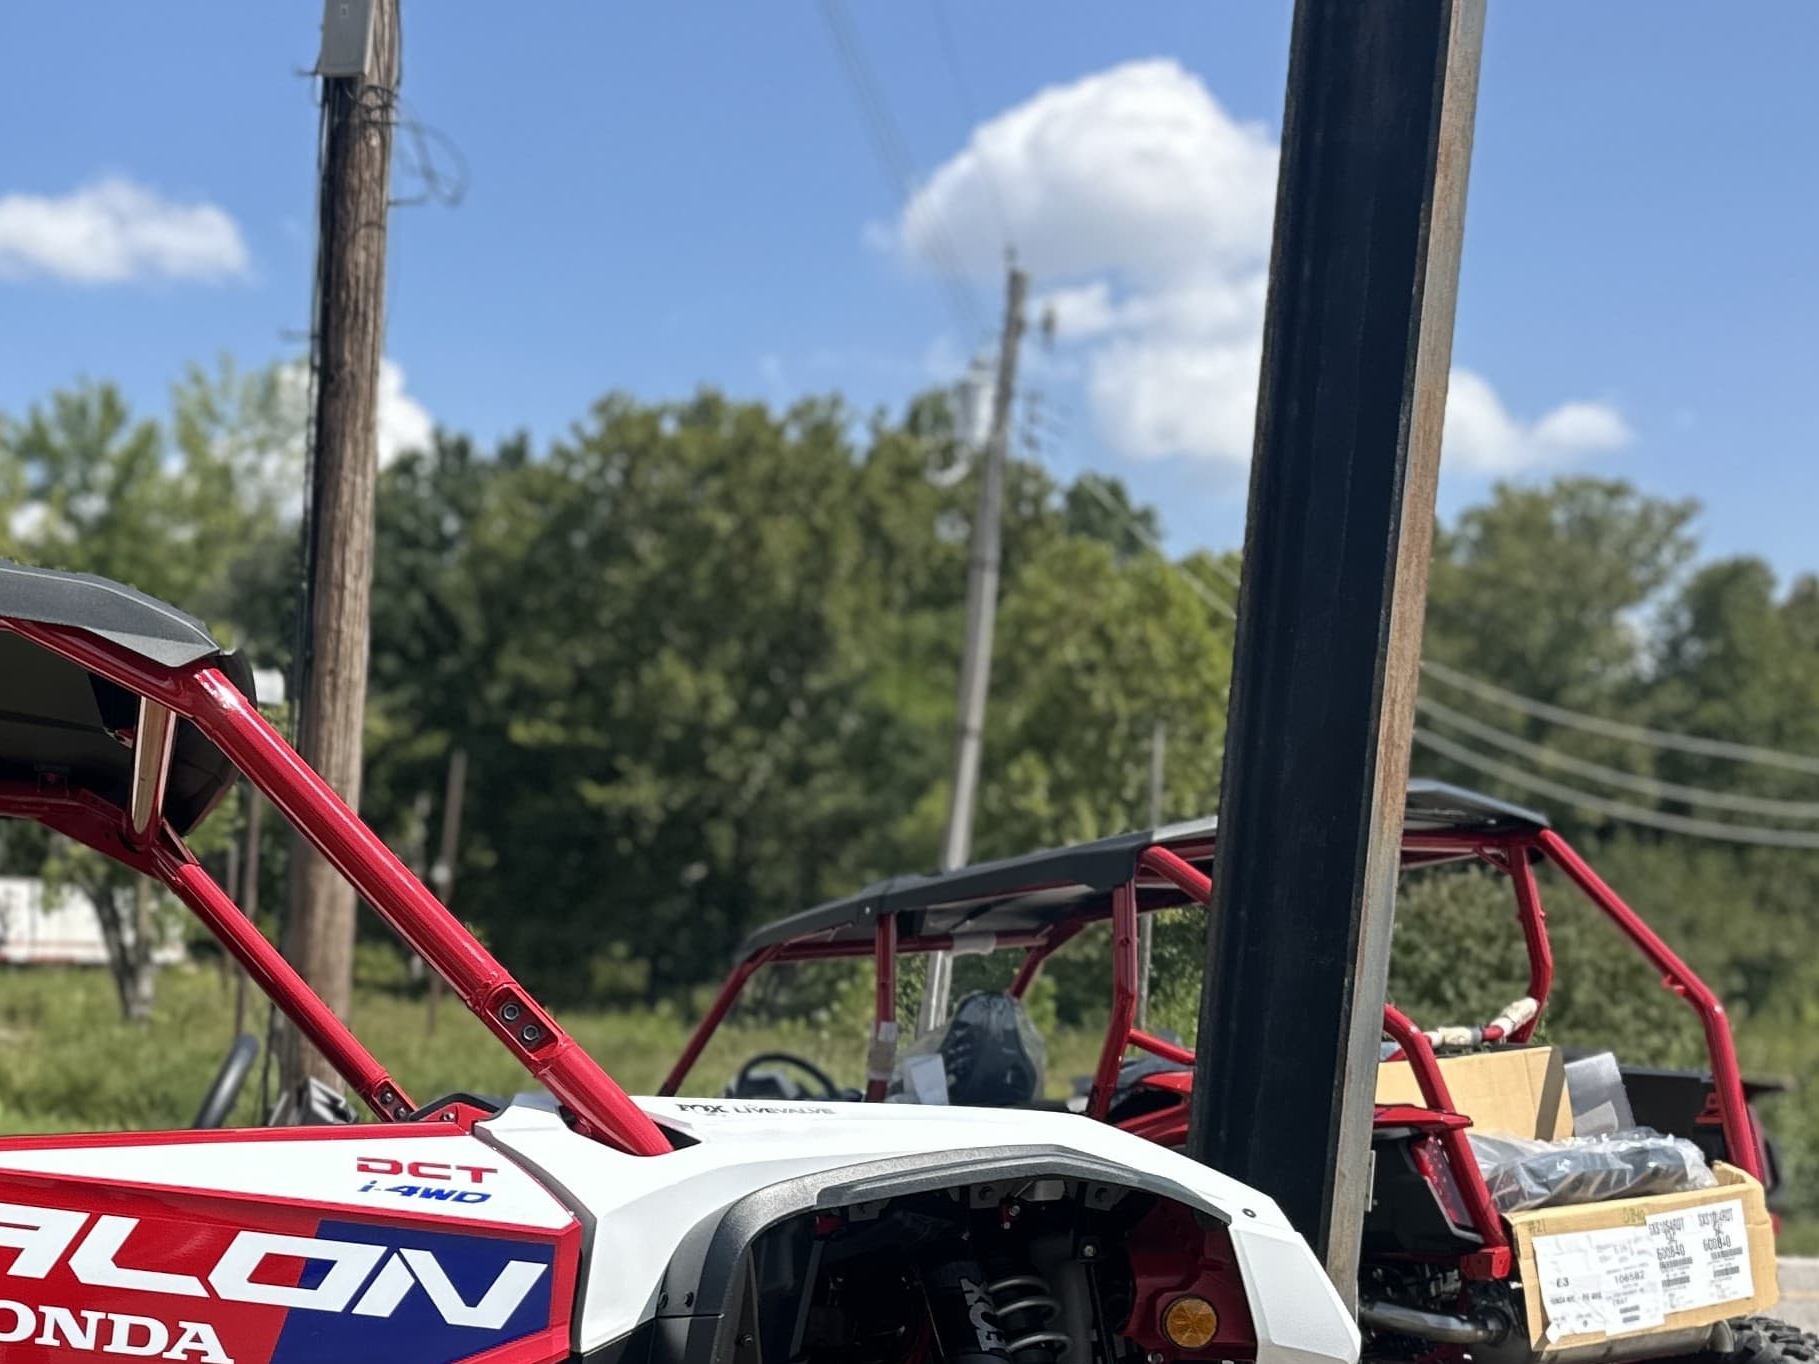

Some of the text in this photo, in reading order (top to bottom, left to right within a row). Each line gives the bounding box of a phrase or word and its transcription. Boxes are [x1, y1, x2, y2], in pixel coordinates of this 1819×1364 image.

[675, 1103, 728, 1114] FOX
[357, 1157, 498, 1184] DCT
[357, 1180, 492, 1204] i-4WD
[958, 1277, 1007, 1352] FOX
